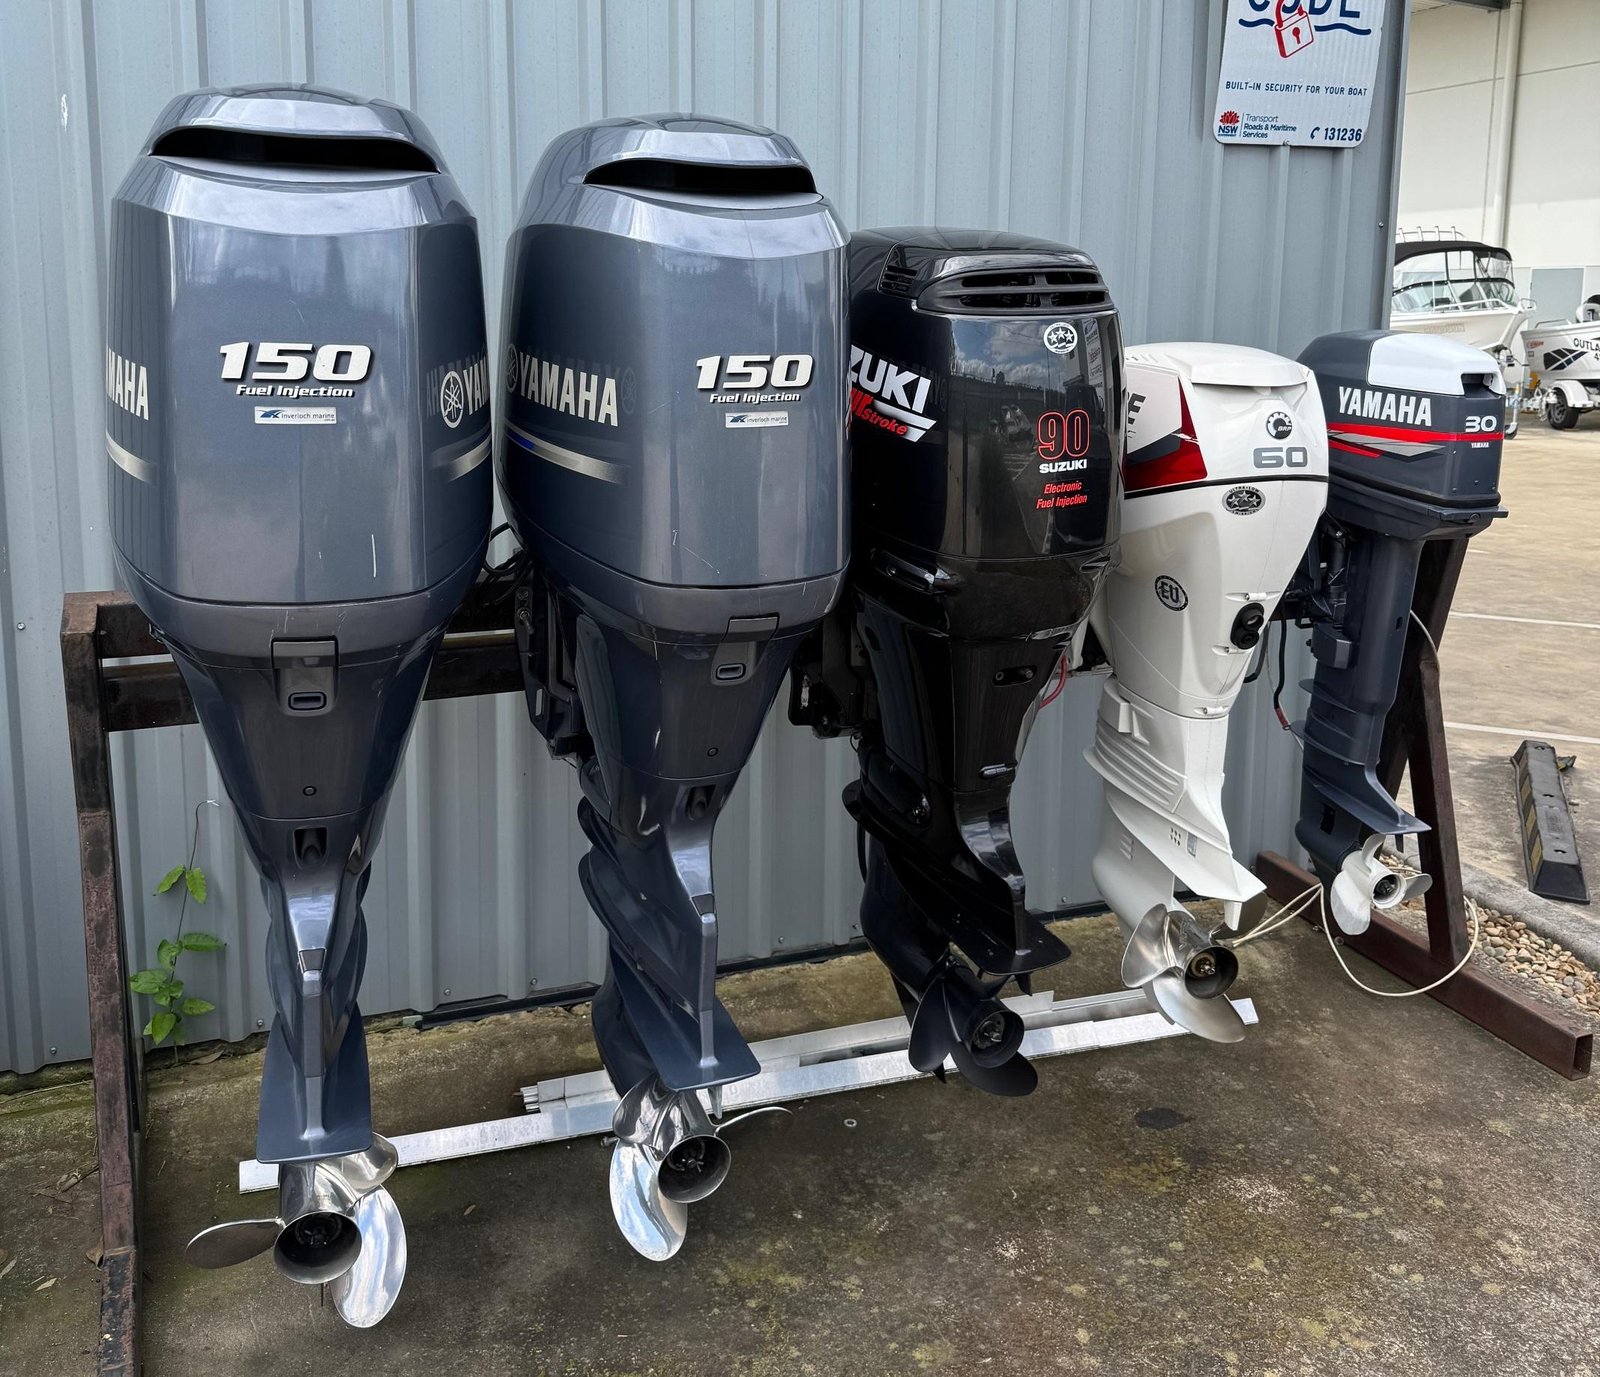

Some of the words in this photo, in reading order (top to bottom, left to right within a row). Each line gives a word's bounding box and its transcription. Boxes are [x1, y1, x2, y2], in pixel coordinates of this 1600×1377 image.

[1225, 80, 1262, 91] BUILT-IN
[1265, 83, 1303, 93] SECURITY
[1305, 85, 1321, 94] FOR
[1324, 86, 1345, 95] YOUR
[1347, 87, 1368, 97] BOAT
[1245, 113, 1279, 123] Transport
[1218, 125, 1239, 133] NSW
[1242, 130, 1269, 139] Services
[1243, 122, 1264, 131] Roads
[1263, 123, 1269, 131] &
[1269, 123, 1298, 132] Maritime
[1323, 127, 1363, 142] 131236
[1573, 337, 1600, 353] OUTLA
[220, 341, 373, 382] 150
[695, 354, 814, 390] 150
[236, 384, 274, 397] Fuel
[277, 385, 355, 399] Injection
[519, 351, 619, 427] YAMAHA
[709, 393, 740, 404] Fuel
[742, 392, 801, 405] Injection
[1338, 386, 1432, 427] YAMAHA
[312, 412, 335, 420] marine
[1465, 415, 1498, 433] 30
[1037, 408, 1090, 461] 90
[1252, 446, 1308, 469] 60
[1038, 458, 1088, 474] SUZUKI
[1043, 480, 1083, 495] Electronic
[1036, 497, 1054, 510] Fuel
[1055, 493, 1088, 508] Injection
